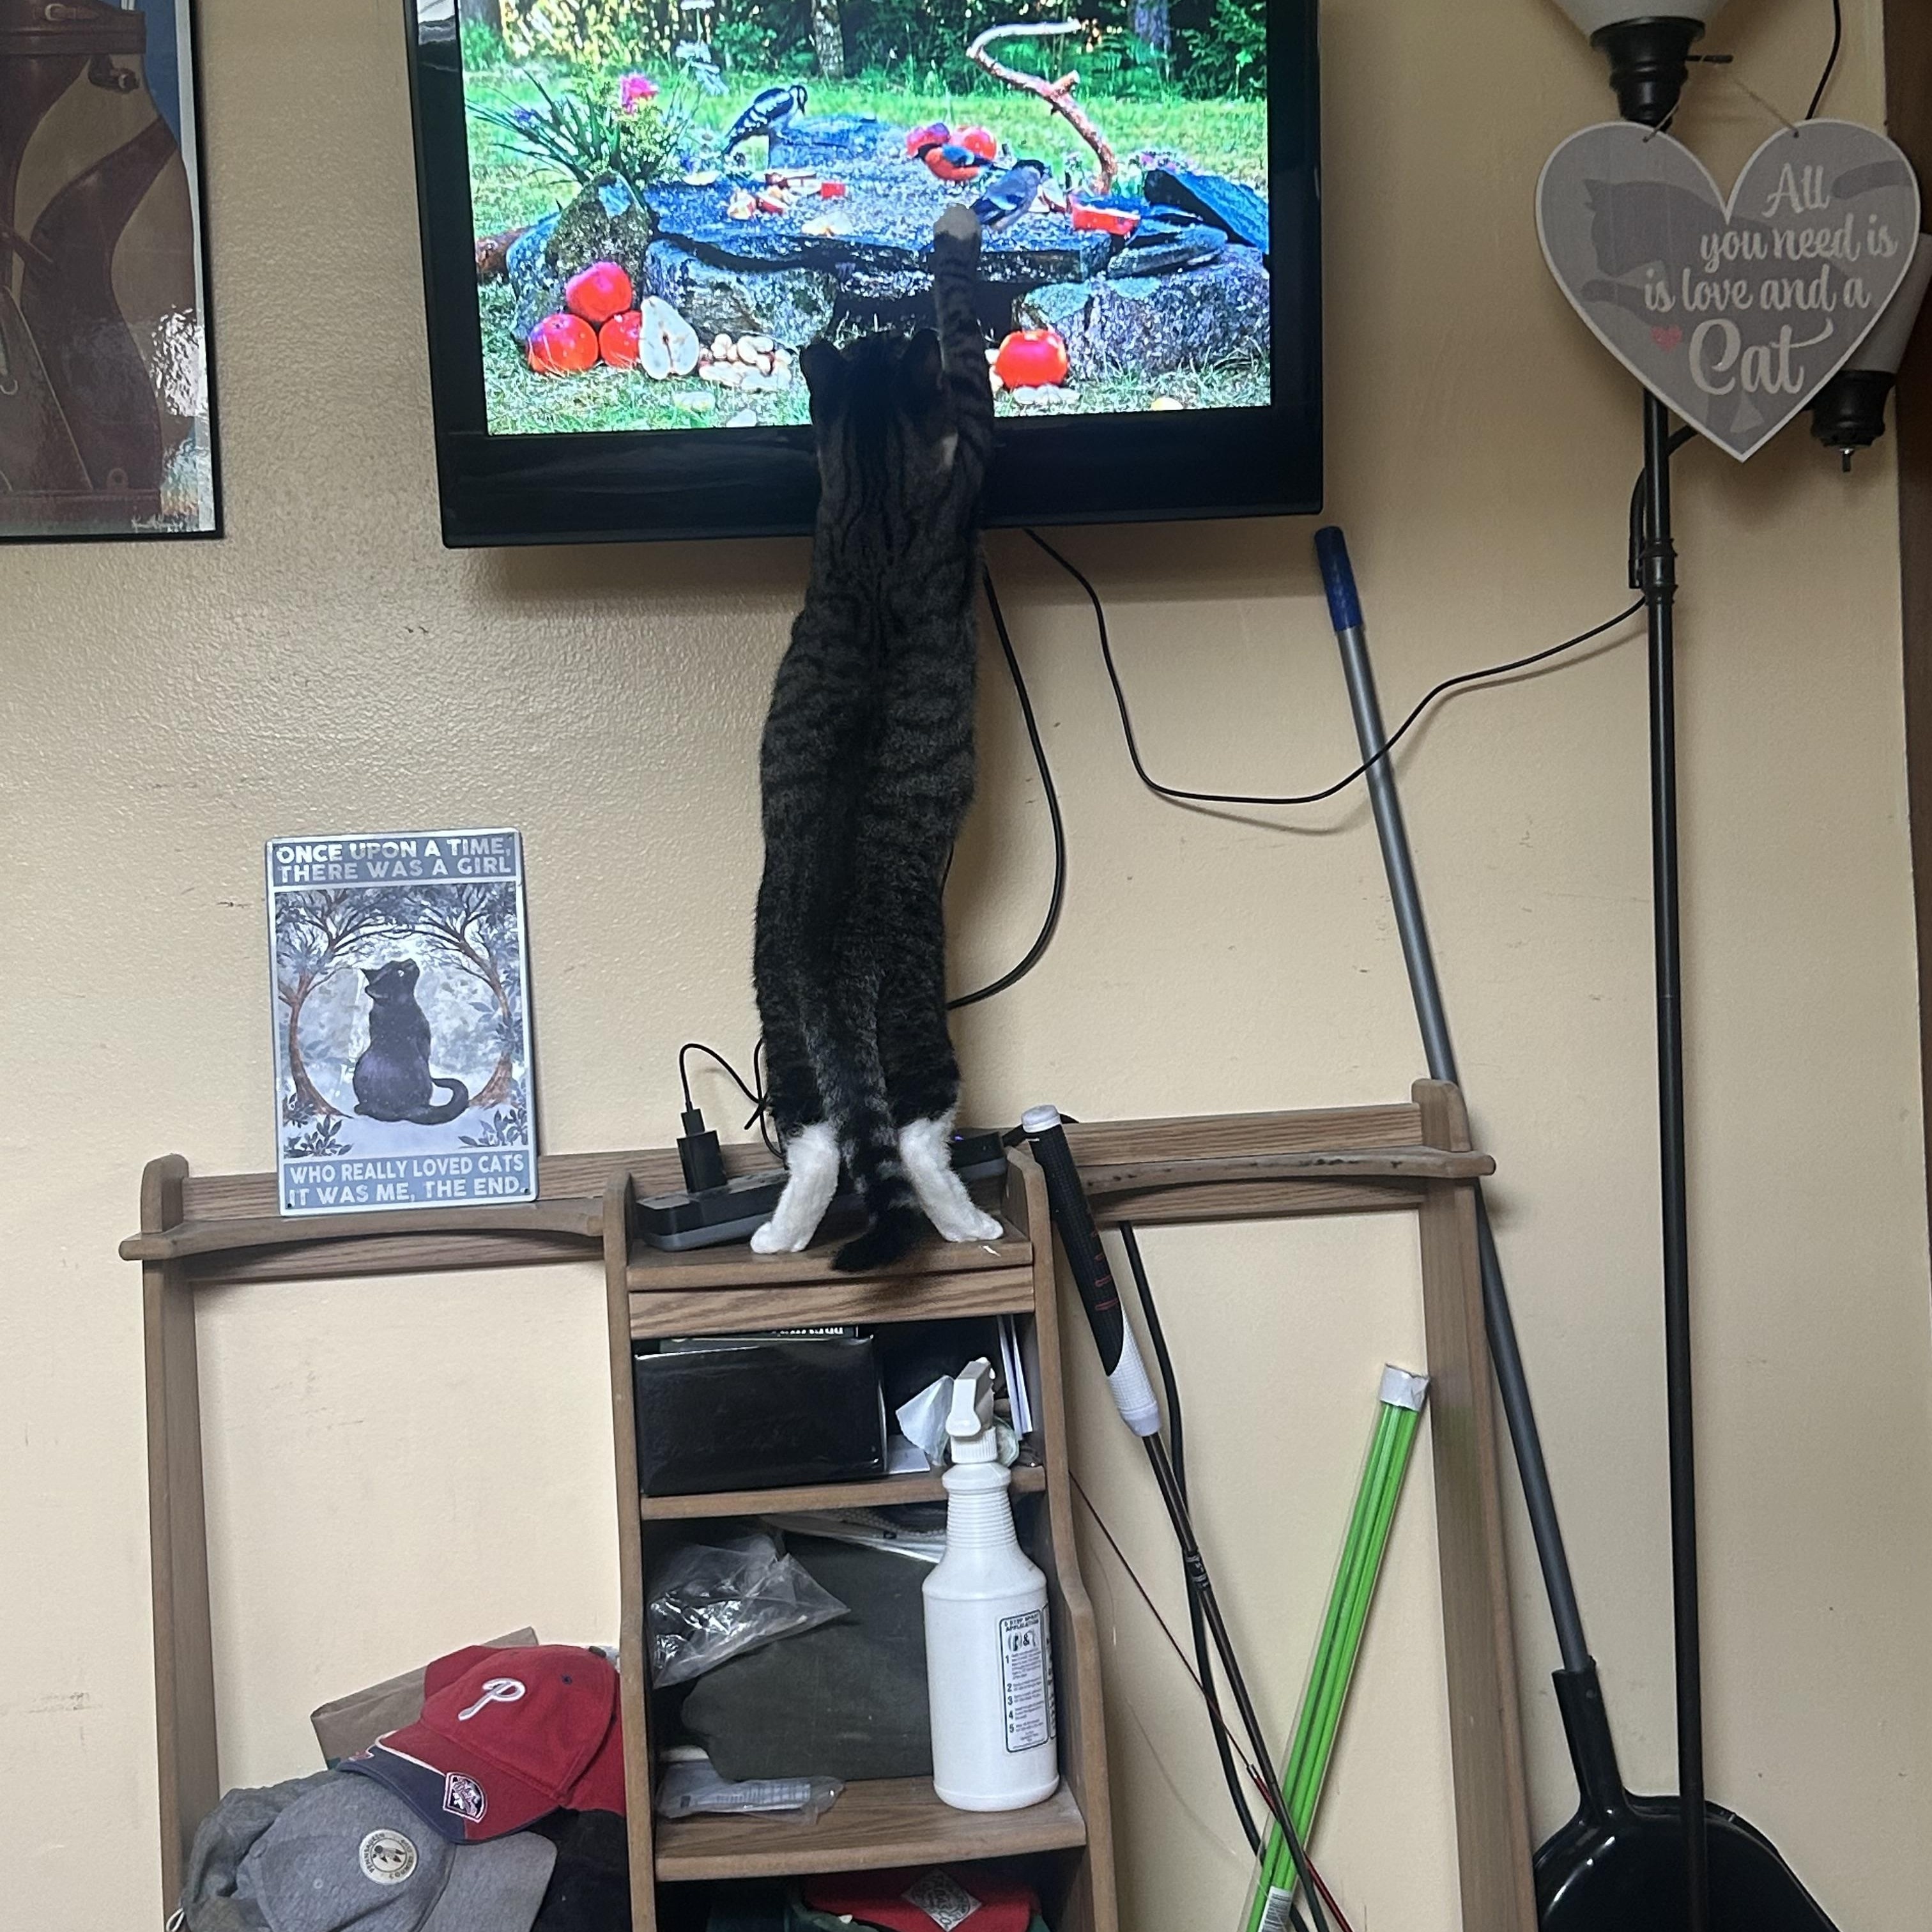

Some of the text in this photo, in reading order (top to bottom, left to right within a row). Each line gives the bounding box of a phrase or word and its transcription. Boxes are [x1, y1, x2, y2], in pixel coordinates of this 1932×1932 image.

[1762, 163, 1830, 218] All
[1700, 213, 1897, 274] you need is
[1644, 263, 1871, 312] is love and a
[1689, 318, 1834, 395] Cat
[276, 836, 511, 864] ONCE UPON A TIME,
[279, 855, 511, 883] THERE WAS A GIRL
[289, 1154, 525, 1184] WHO REALLY LOVED CATS
[289, 1176, 525, 1207] IT WAS ME, THE END.
[1005, 1655, 1009, 1664] 1
[457, 1677, 526, 1721] P
[1007, 1683, 1012, 1692] 2
[1008, 1696, 1013, 1705] 3
[1009, 1710, 1013, 1719] 4
[1009, 1723, 1015, 1733] 5
